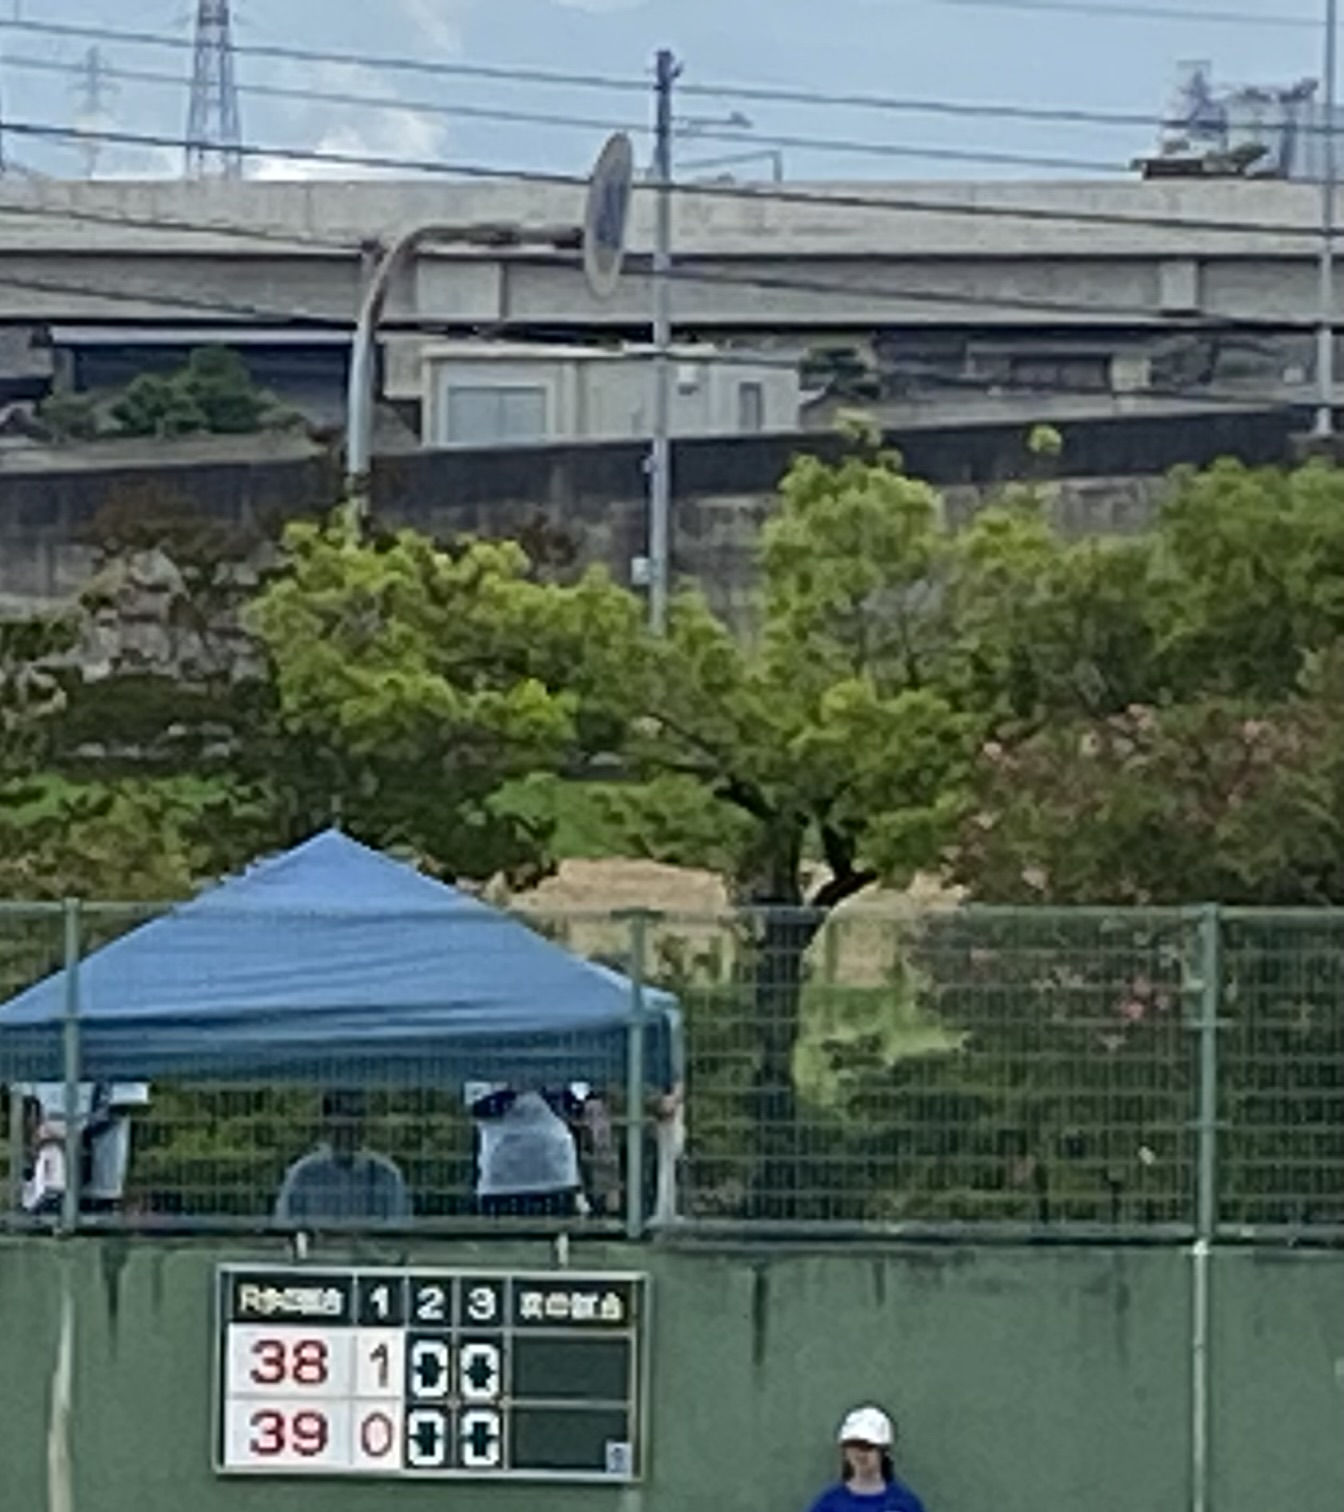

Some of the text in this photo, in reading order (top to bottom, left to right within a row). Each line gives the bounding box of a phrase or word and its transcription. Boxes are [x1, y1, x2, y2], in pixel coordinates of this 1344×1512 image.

[369, 1288, 388, 1317] 1
[417, 1288, 444, 1319] 2
[468, 1288, 496, 1320] 3
[249, 1339, 329, 1385] 38
[369, 1343, 388, 1387] 1
[249, 1411, 329, 1457] 39
[360, 1412, 394, 1457] 0
